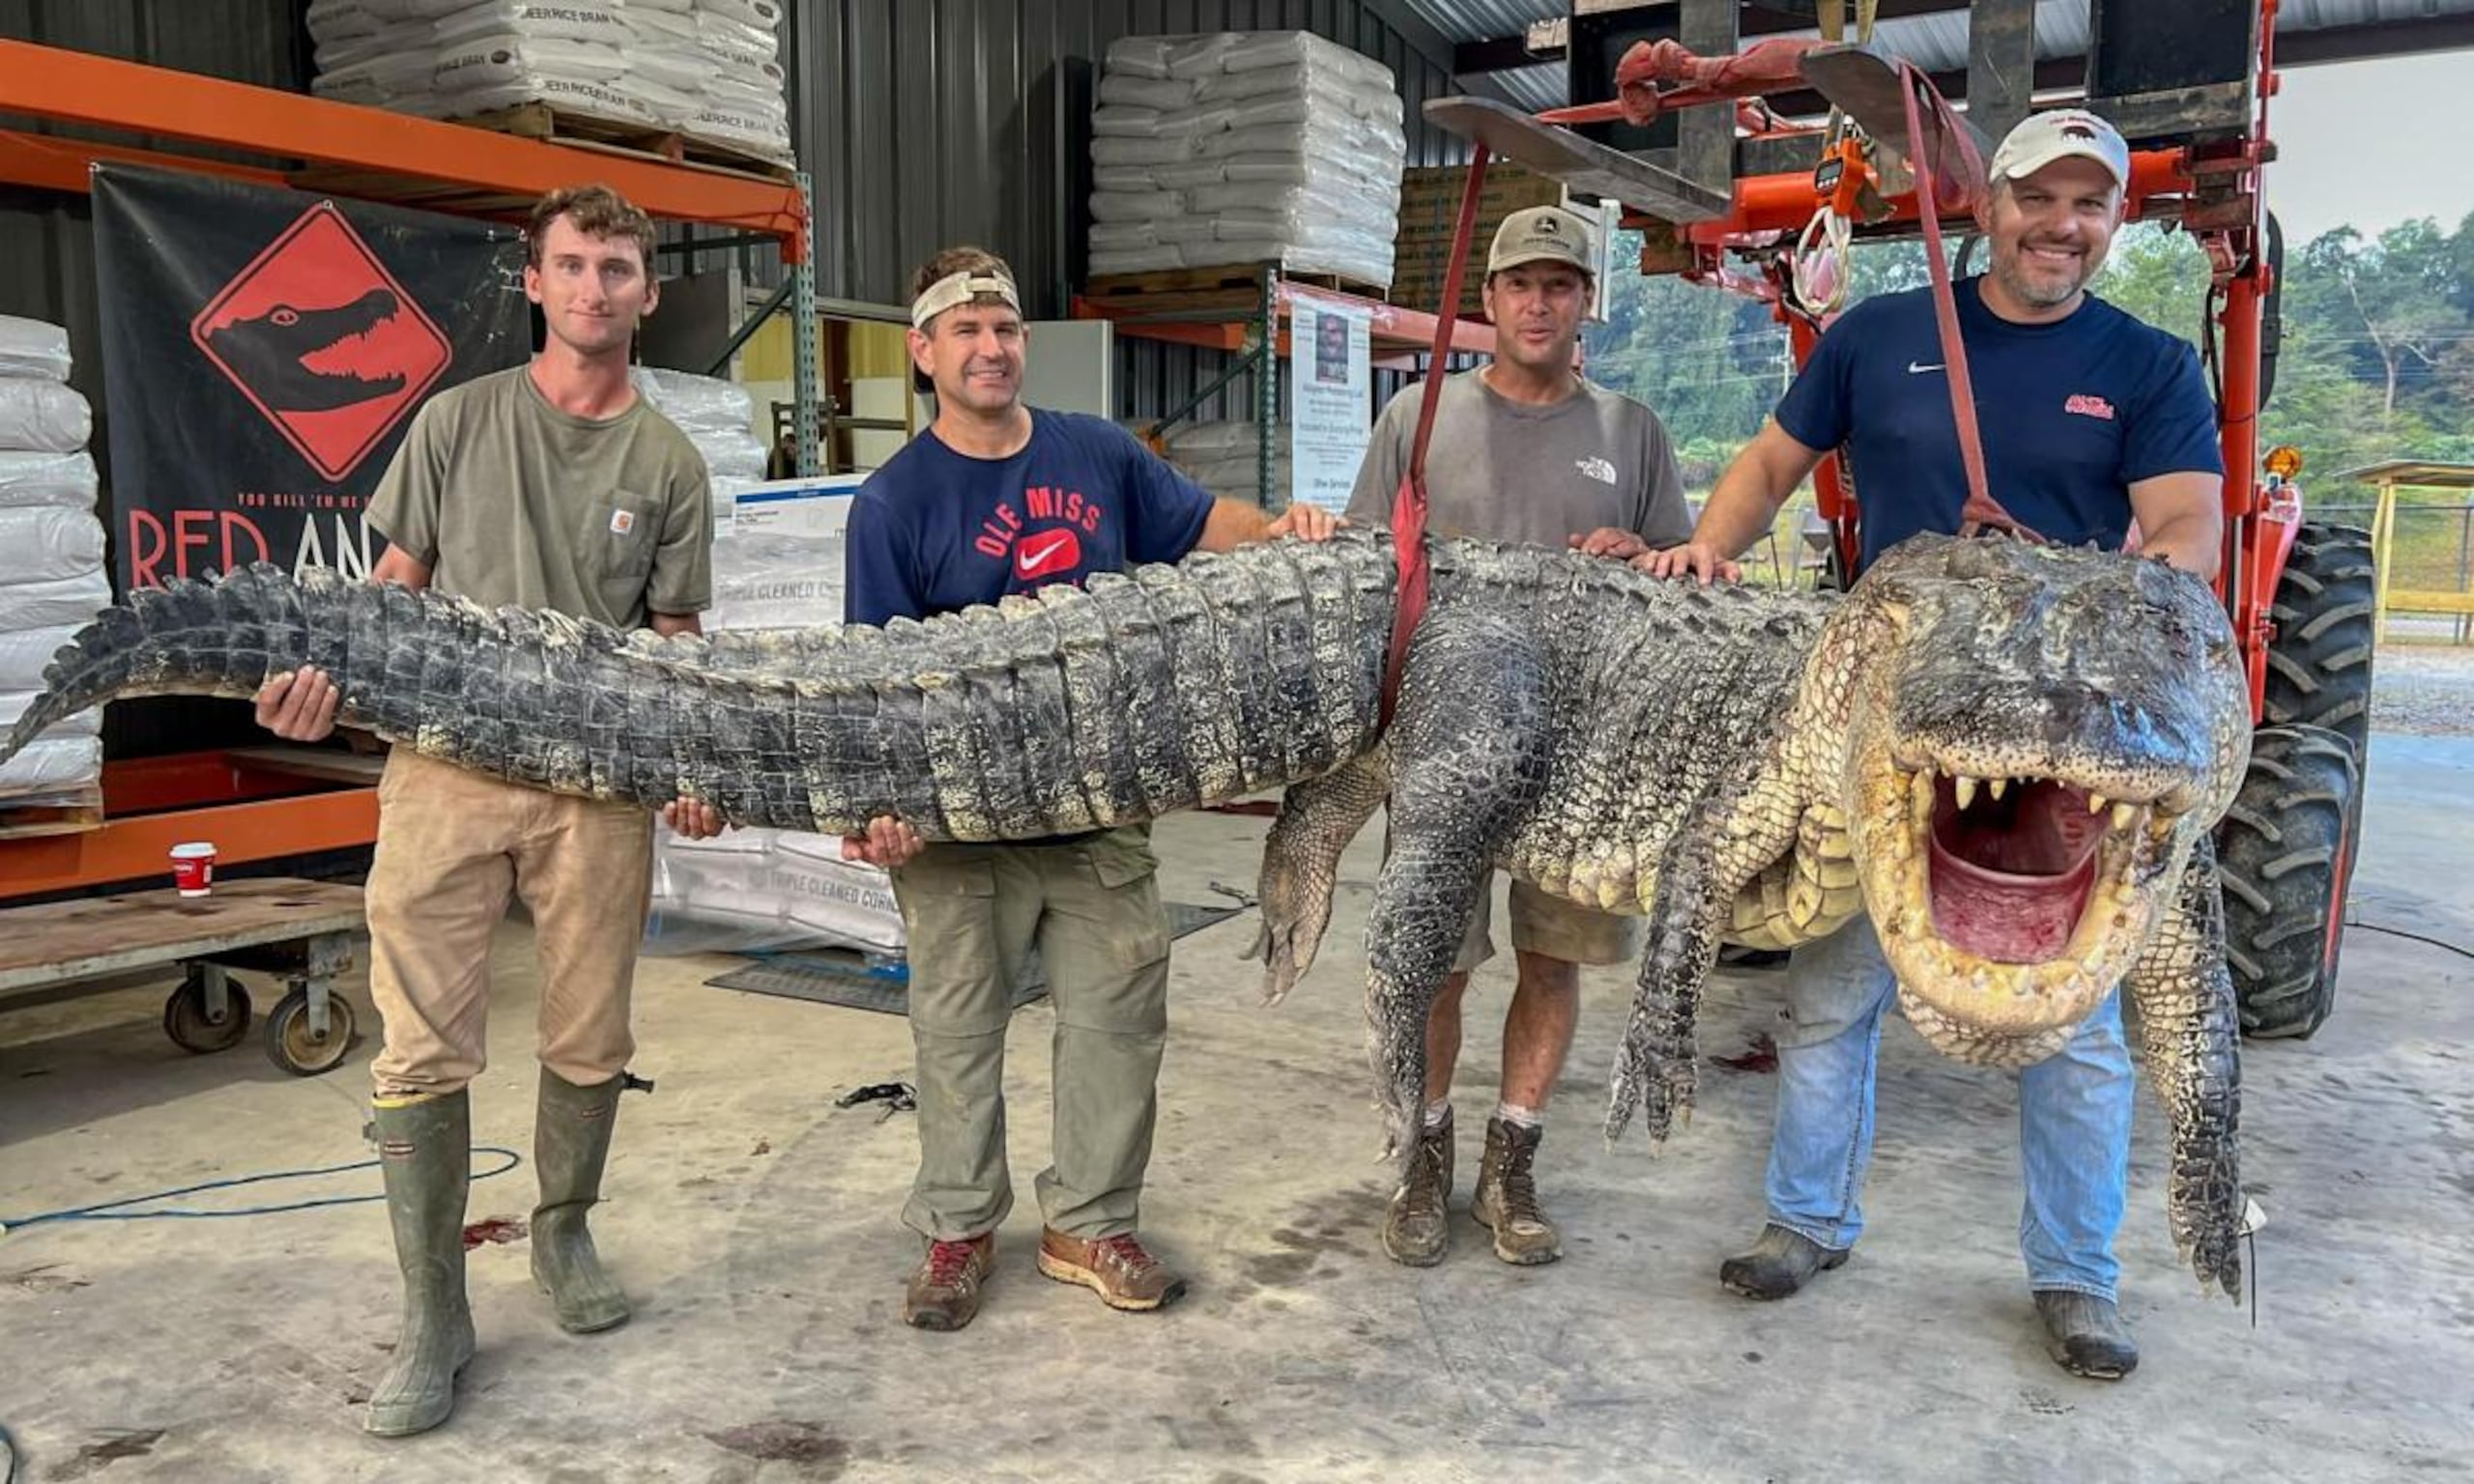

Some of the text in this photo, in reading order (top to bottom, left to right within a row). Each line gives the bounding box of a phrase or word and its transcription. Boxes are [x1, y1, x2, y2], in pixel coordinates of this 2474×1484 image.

[129, 509, 273, 595] RED
[975, 486, 1101, 557] OLE MISS
[808, 876, 859, 904] CLEANED
[861, 889, 900, 913] CORN
